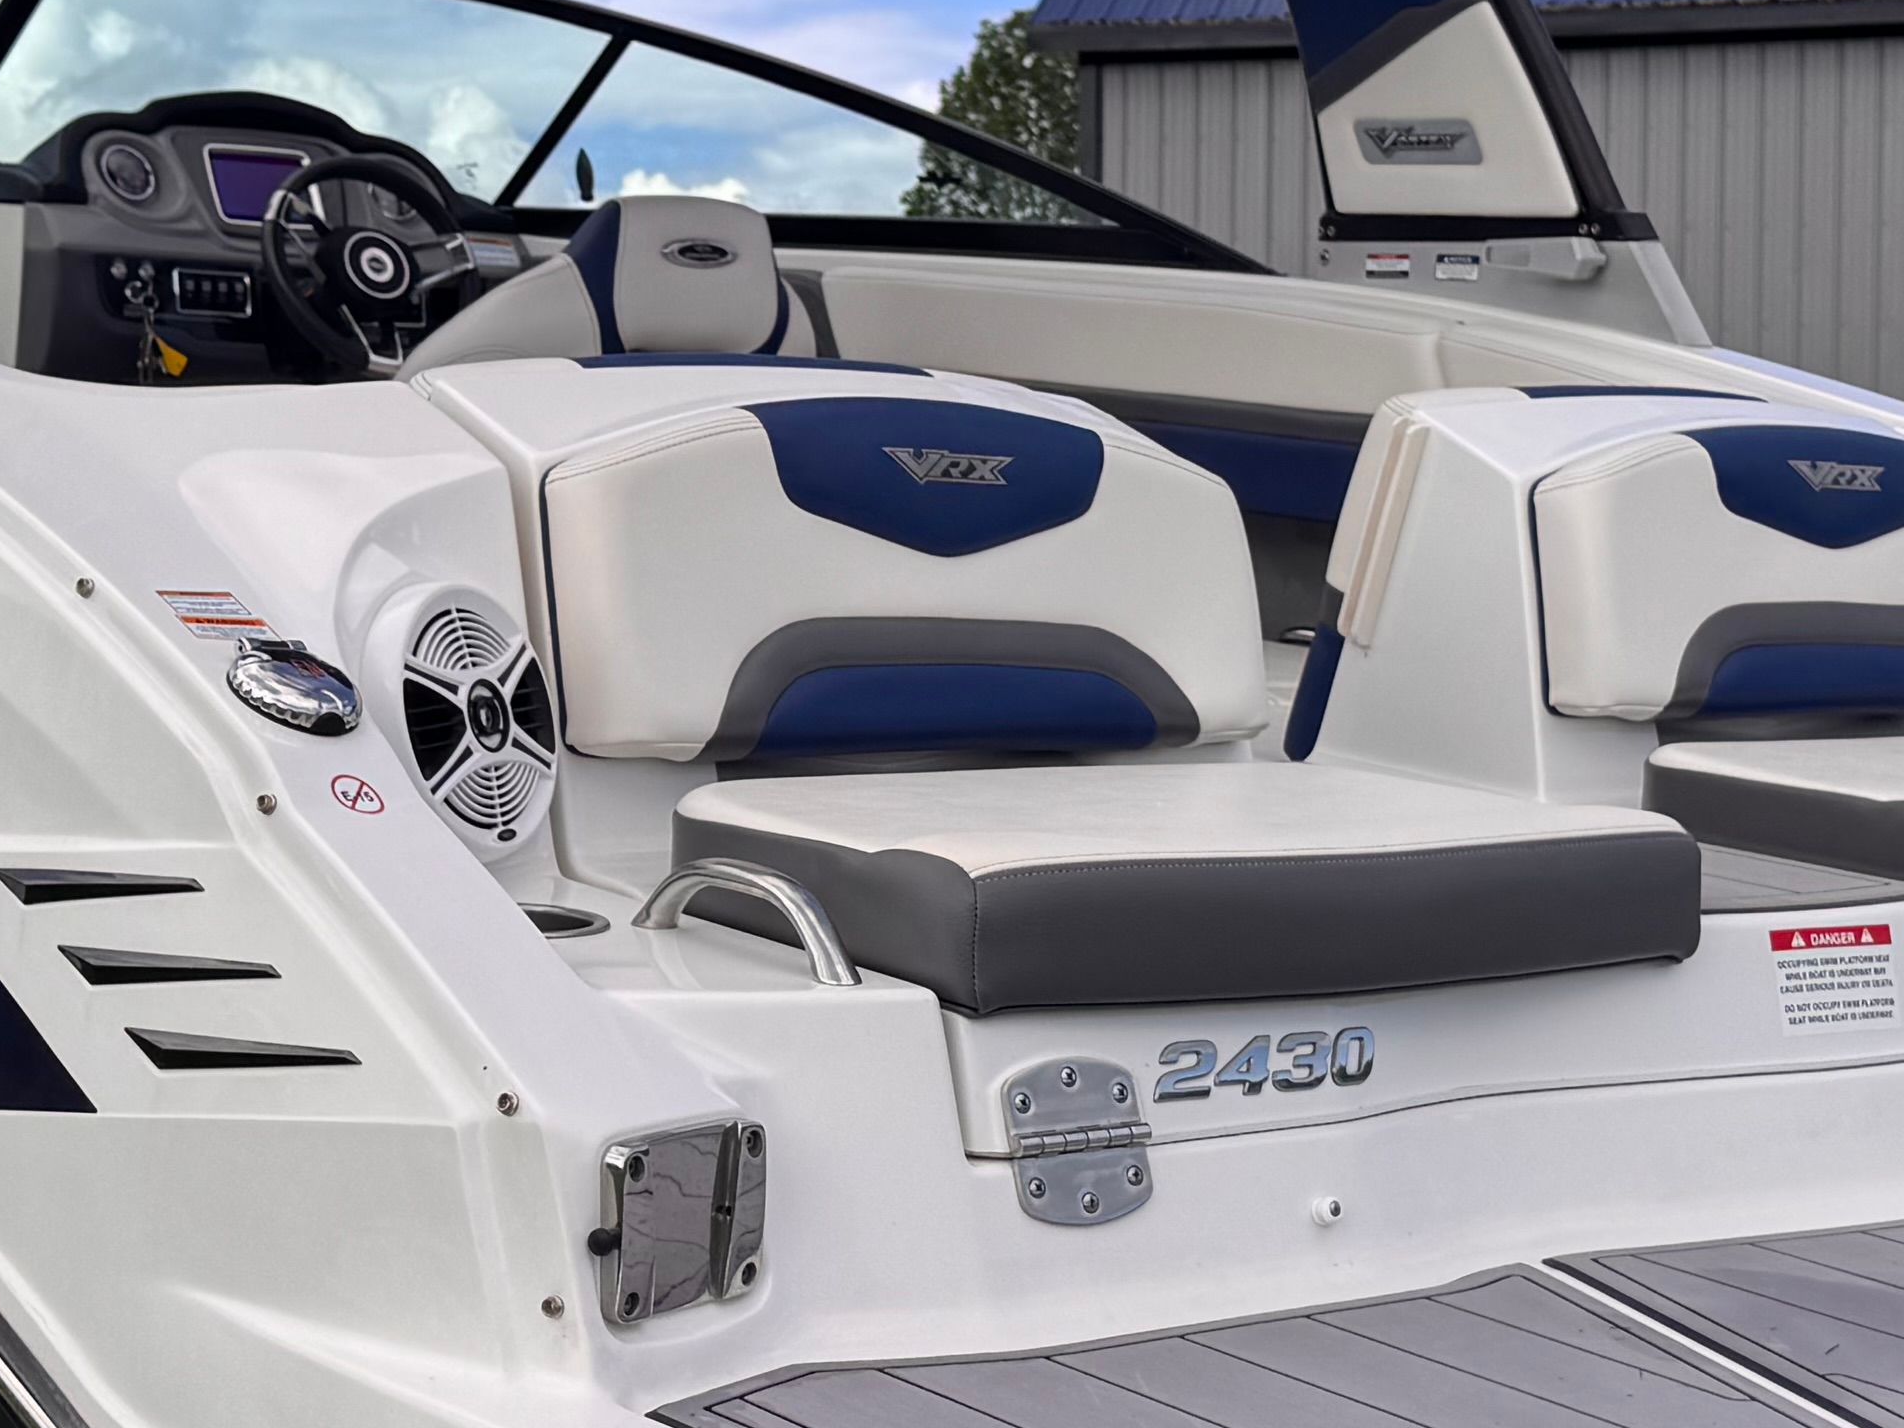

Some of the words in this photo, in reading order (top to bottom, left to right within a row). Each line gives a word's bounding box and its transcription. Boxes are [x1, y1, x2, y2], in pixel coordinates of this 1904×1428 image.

[886, 447, 1008, 483] VRX
[1790, 461, 1882, 491] VRX
[1810, 931, 1856, 946] DANGER
[1152, 1025, 1376, 1104] 2430
